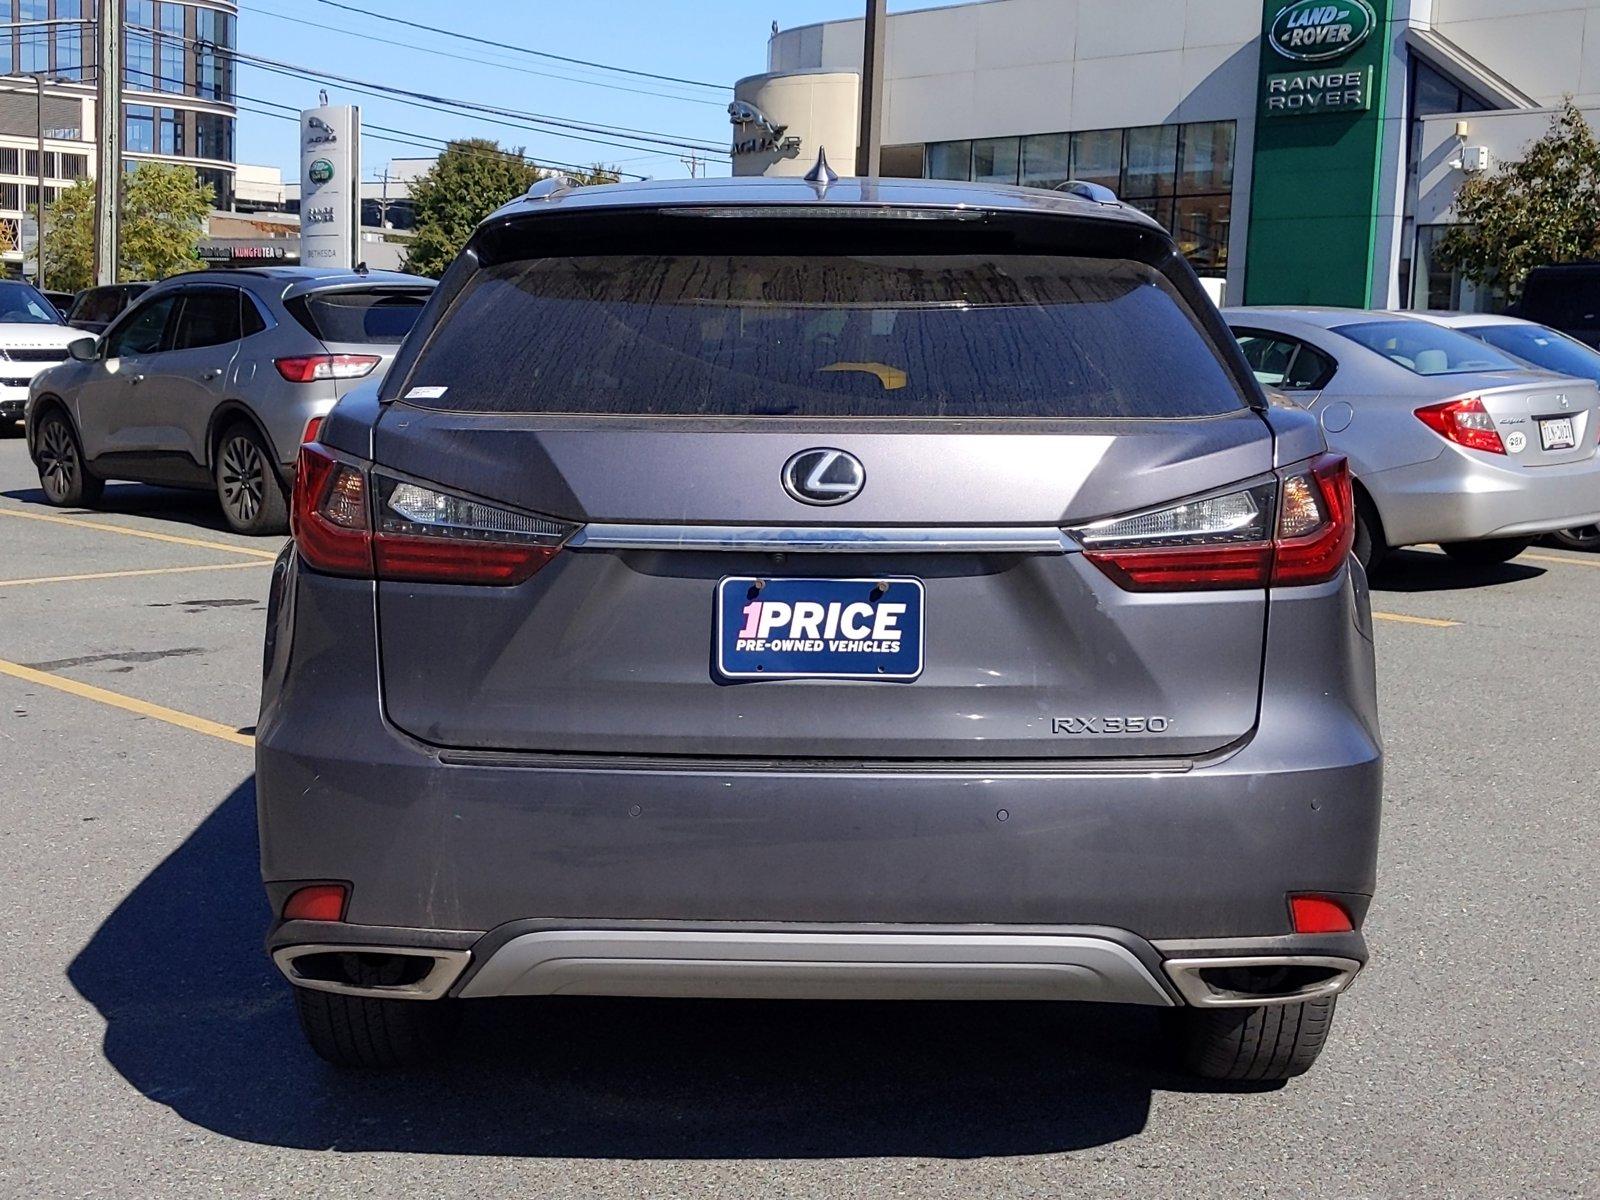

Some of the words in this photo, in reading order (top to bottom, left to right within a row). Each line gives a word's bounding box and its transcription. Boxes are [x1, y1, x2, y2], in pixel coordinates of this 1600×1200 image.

[1269, 71, 1361, 93] RANGE
[1267, 90, 1361, 110] ROVER
[736, 639, 824, 652] PRE-OWNED
[829, 640, 900, 653] VEHICLES
[1051, 716, 1099, 734] RX
[1102, 715, 1169, 734] 350
